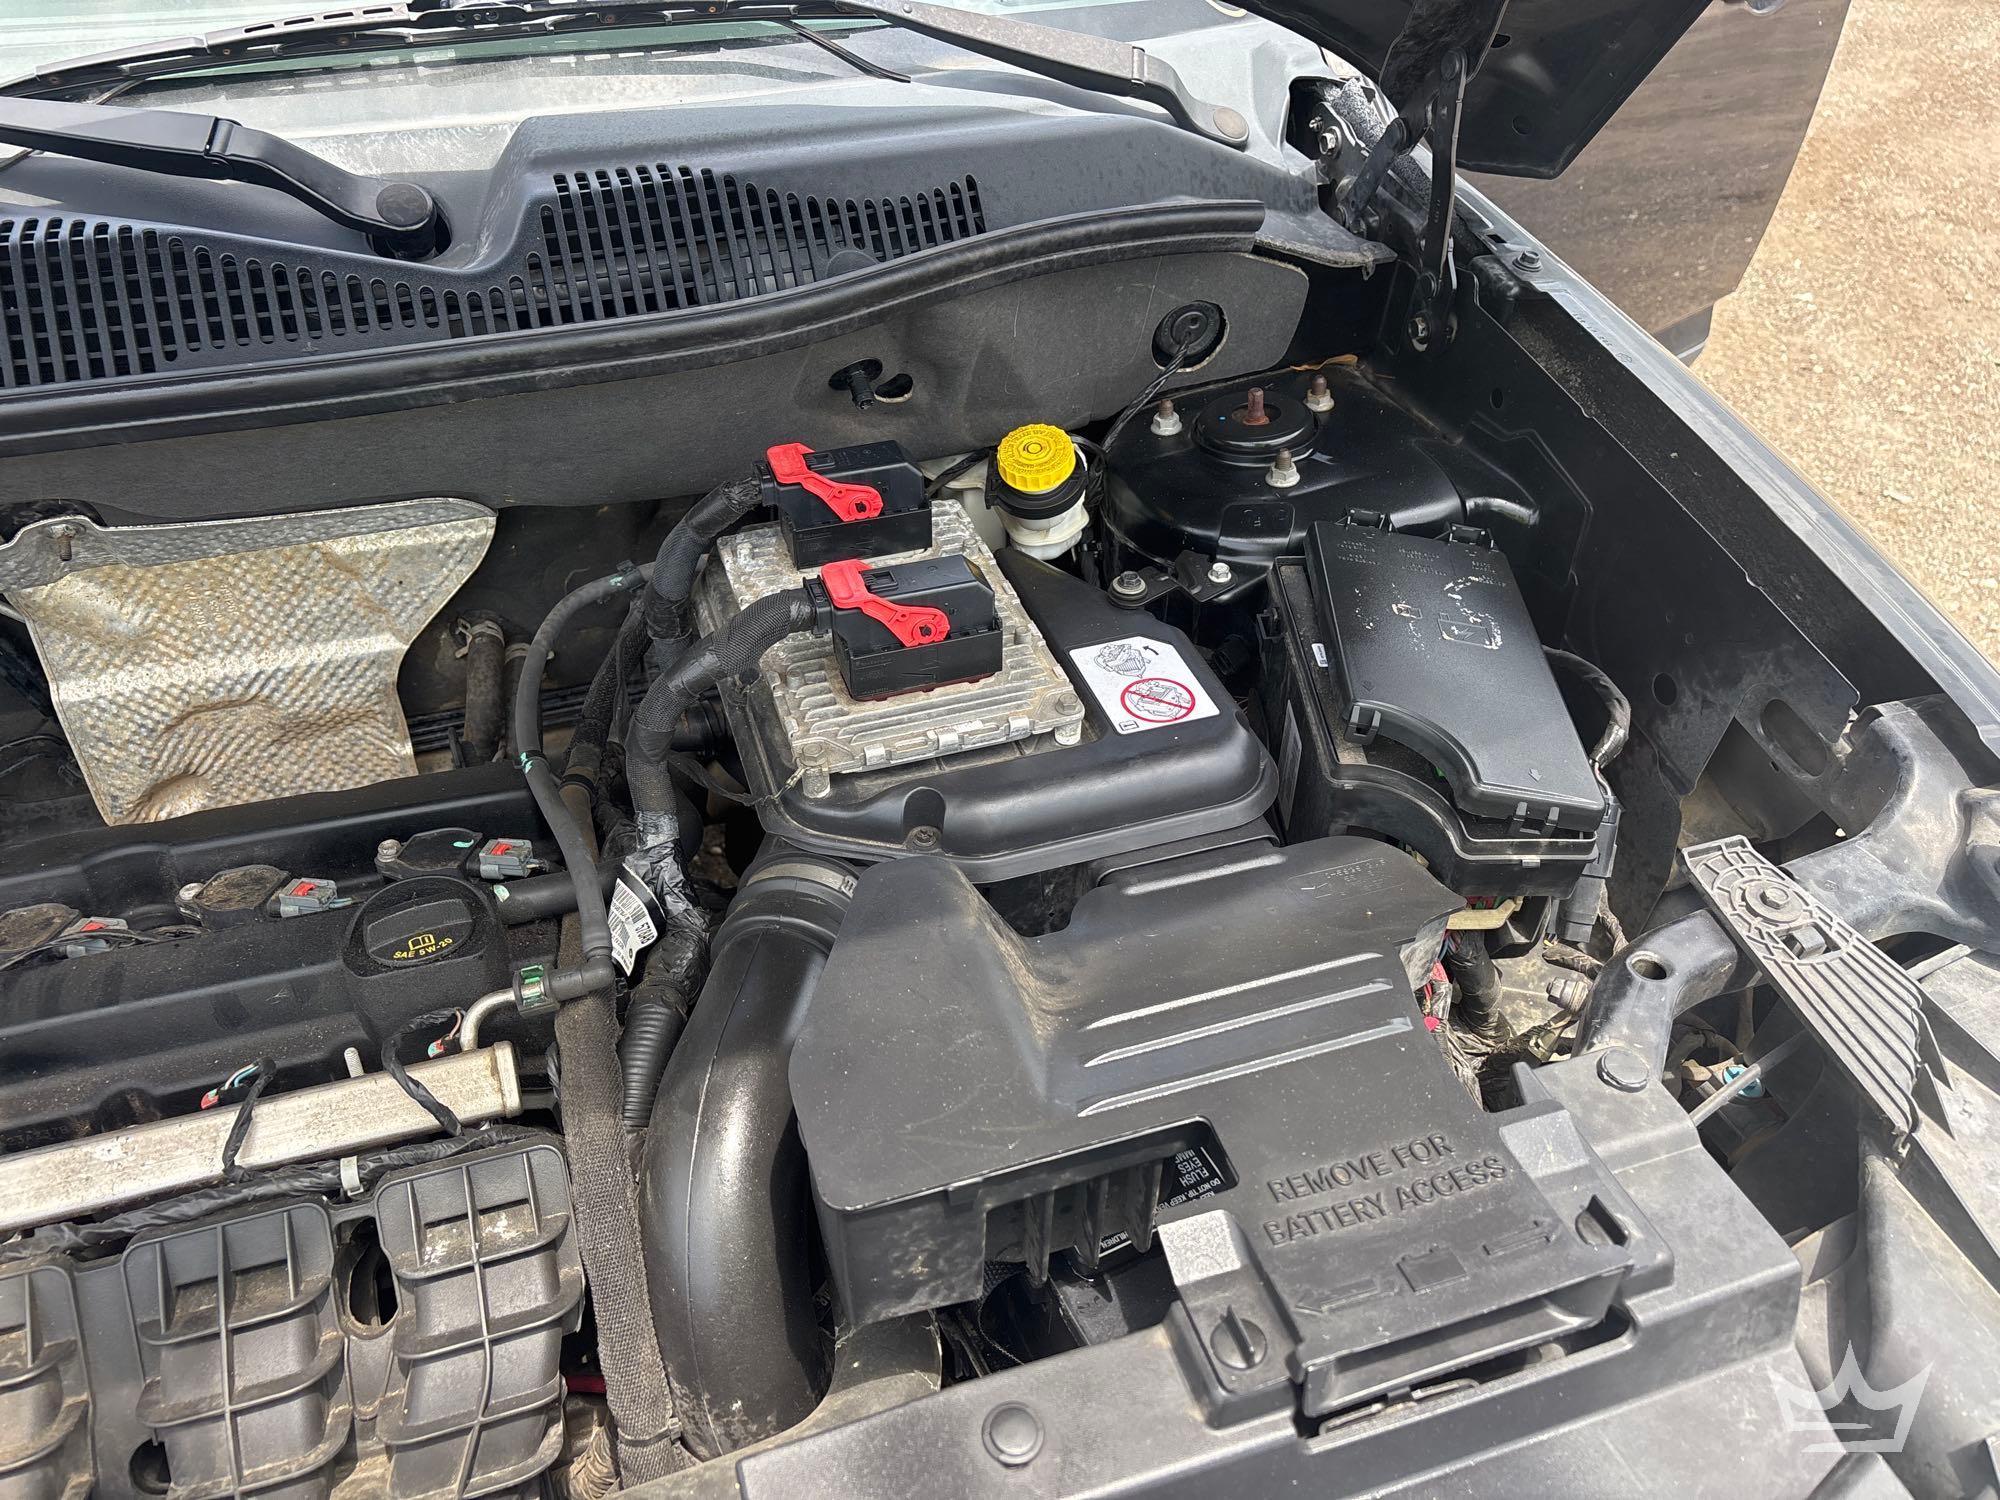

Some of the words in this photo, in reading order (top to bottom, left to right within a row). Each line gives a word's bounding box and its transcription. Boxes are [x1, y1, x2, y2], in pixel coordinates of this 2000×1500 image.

[393, 950, 416, 959] SAE
[419, 937, 453, 956] 5W-20
[1177, 1157, 1203, 1174] EYES
[1266, 1151, 1393, 1203] REMOVE
[1391, 1132, 1455, 1169] FOR
[1178, 1167, 1210, 1187] FLUSH
[1209, 1178, 1221, 1187] DO
[1198, 1182, 1212, 1192] NOT
[1169, 1193, 1187, 1207] KEEP
[1263, 1191, 1388, 1247] BATTERY
[1395, 1155, 1507, 1211] ACCESS
